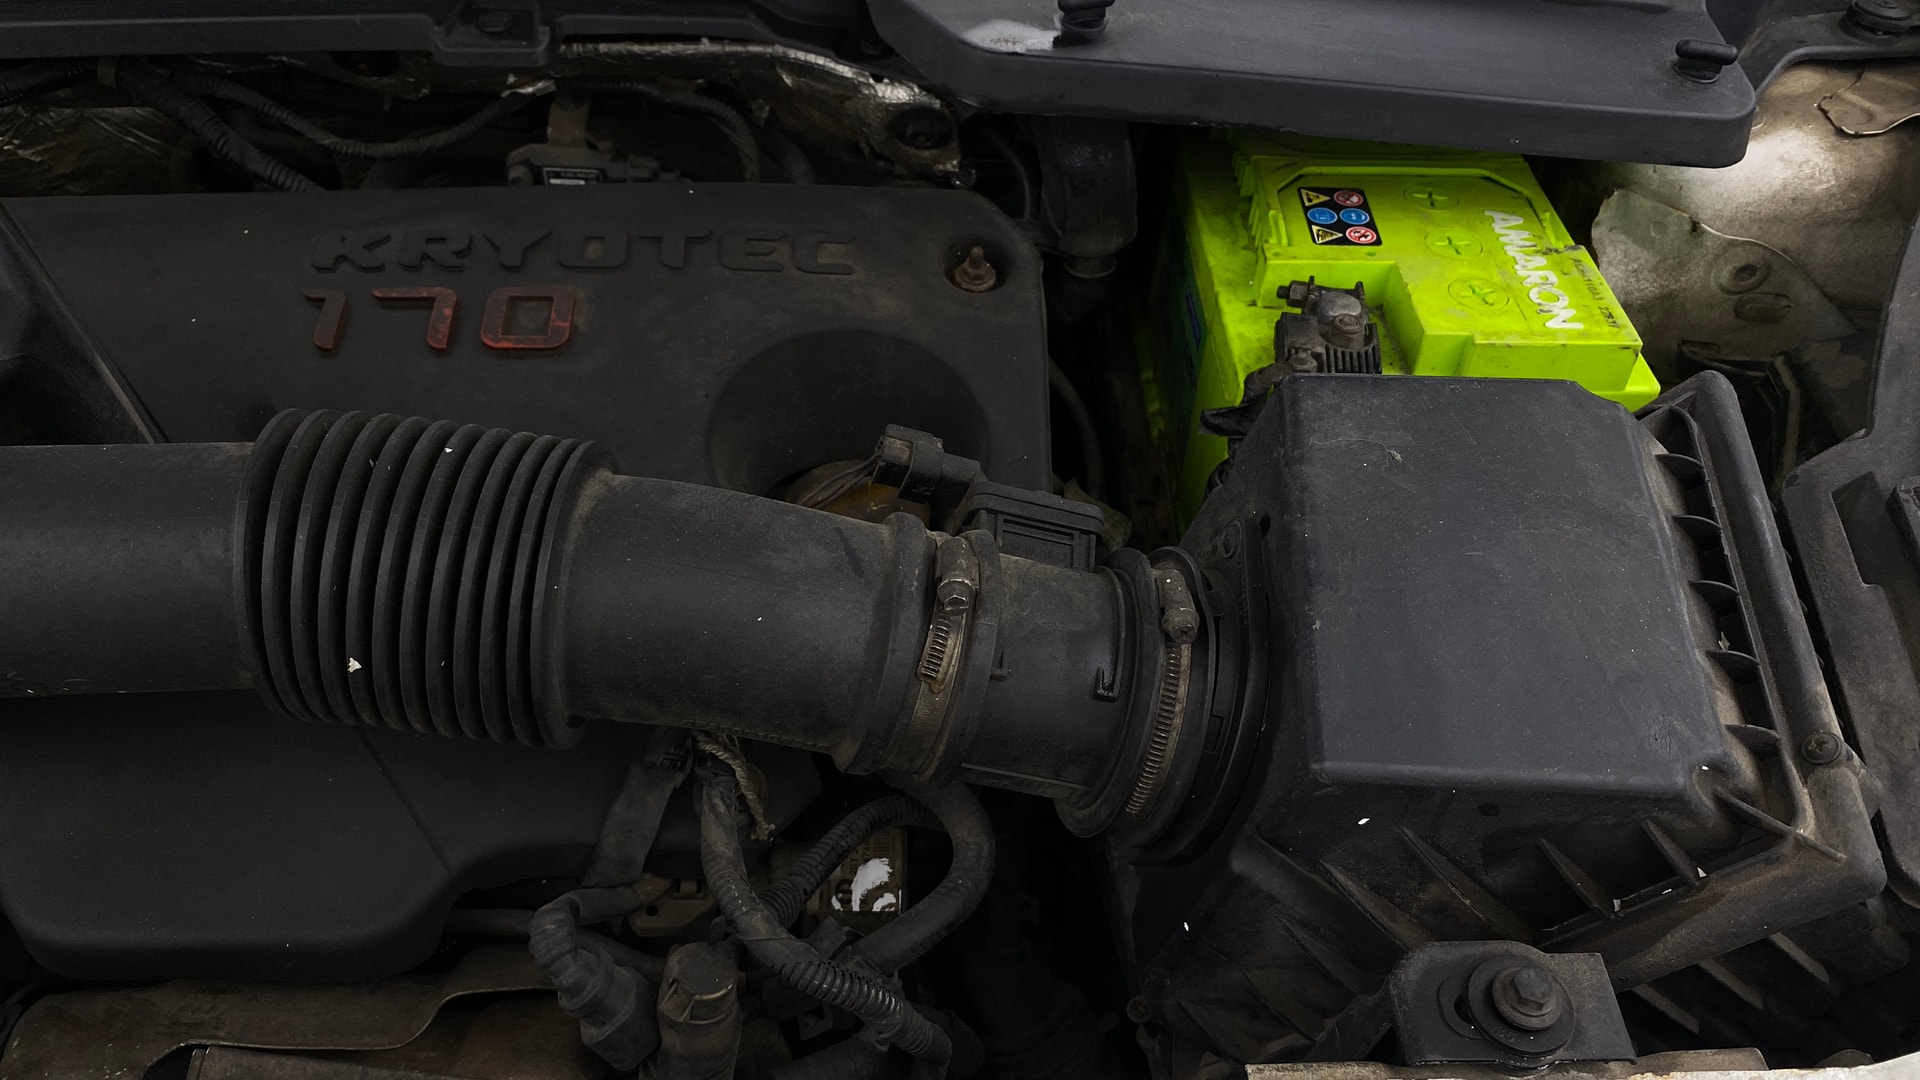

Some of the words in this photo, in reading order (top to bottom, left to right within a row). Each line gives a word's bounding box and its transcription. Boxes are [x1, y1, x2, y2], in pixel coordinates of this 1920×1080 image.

[310, 229, 857, 275] KRYOTEC
[1484, 210, 1585, 330] AMARON
[303, 286, 576, 351] 170
